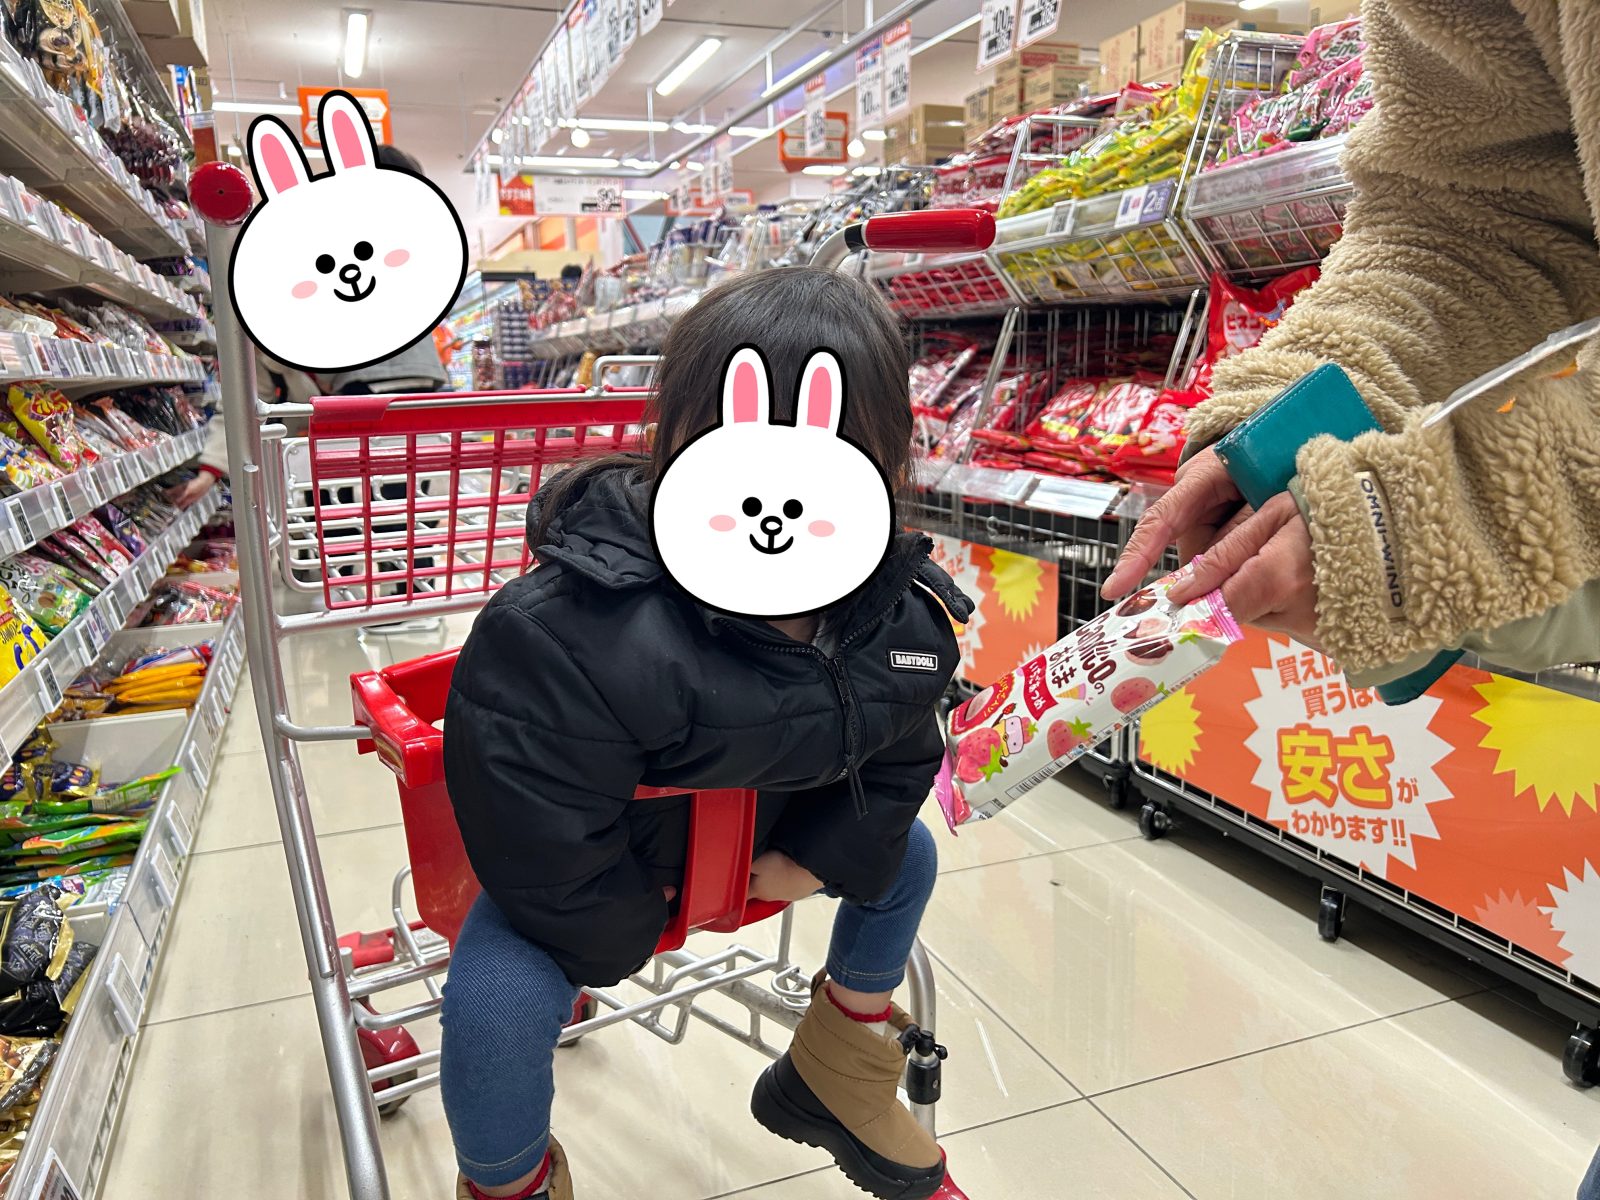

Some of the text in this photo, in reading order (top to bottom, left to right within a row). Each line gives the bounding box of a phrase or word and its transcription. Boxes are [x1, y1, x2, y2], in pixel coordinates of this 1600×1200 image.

[1361, 478, 1402, 607] OMNI-WIND
[895, 654, 934, 668] BABYDOLL
[1049, 646, 1077, 688] あたま
[1028, 661, 1047, 711] いちごあつめ
[1302, 682, 1384, 719] 買うほ
[1291, 809, 1407, 848] わかります!!
